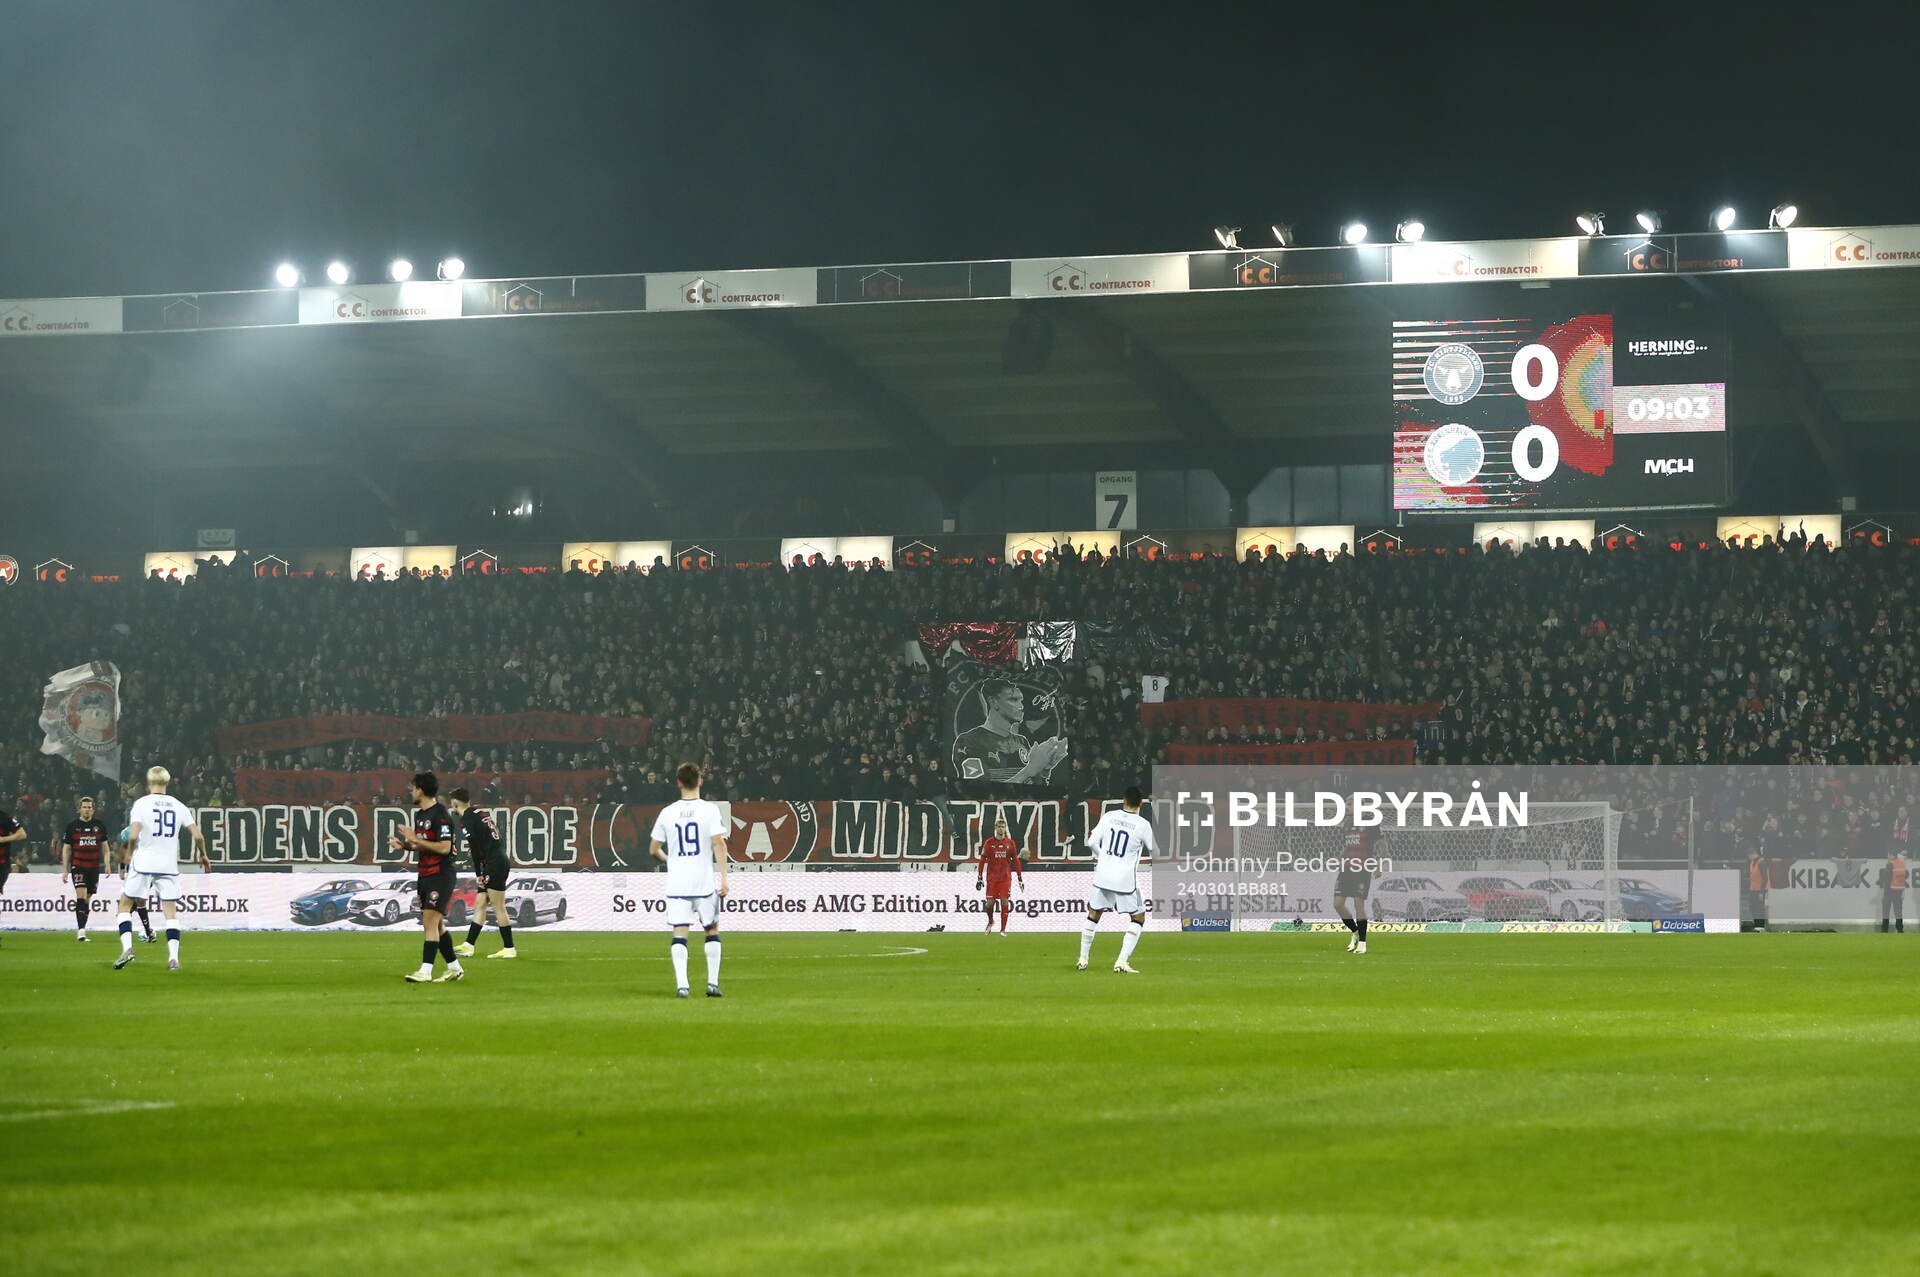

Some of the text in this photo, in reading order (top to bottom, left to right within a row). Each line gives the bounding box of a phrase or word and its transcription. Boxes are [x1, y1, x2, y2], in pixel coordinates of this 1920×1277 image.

[1474, 266, 1538, 275] CONTRACTOR
[1089, 280, 1151, 290] CONTRACTOR
[722, 293, 780, 303] CONTRACTOR
[370, 307, 427, 317] CONTRACTOR
[36, 322, 89, 330] CONTRACTOR
[1511, 343, 1559, 401] 0
[1627, 397, 1710, 422] 09:03
[1511, 425, 1559, 482] 0
[1099, 475, 1133, 484] OPGANG
[1103, 494, 1129, 529] 7
[1152, 679, 1158, 692] 8
[152, 808, 176, 838] 39
[831, 798, 1216, 860] MIDTJYLLND
[373, 805, 579, 866] DGE
[675, 822, 700, 857] 19
[1106, 828, 1130, 858] 10
[1791, 868, 1871, 889] KIBK
[147, 895, 248, 912] HSSEL.DK
[613, 895, 637, 913] Se
[812, 894, 866, 913] AMG
[871, 894, 949, 913] Edition
[1171, 893, 1202, 917] på
[1192, 917, 1229, 927] Oddset
[1310, 923, 1353, 933] FAX
[1662, 920, 1701, 930] Oddset
